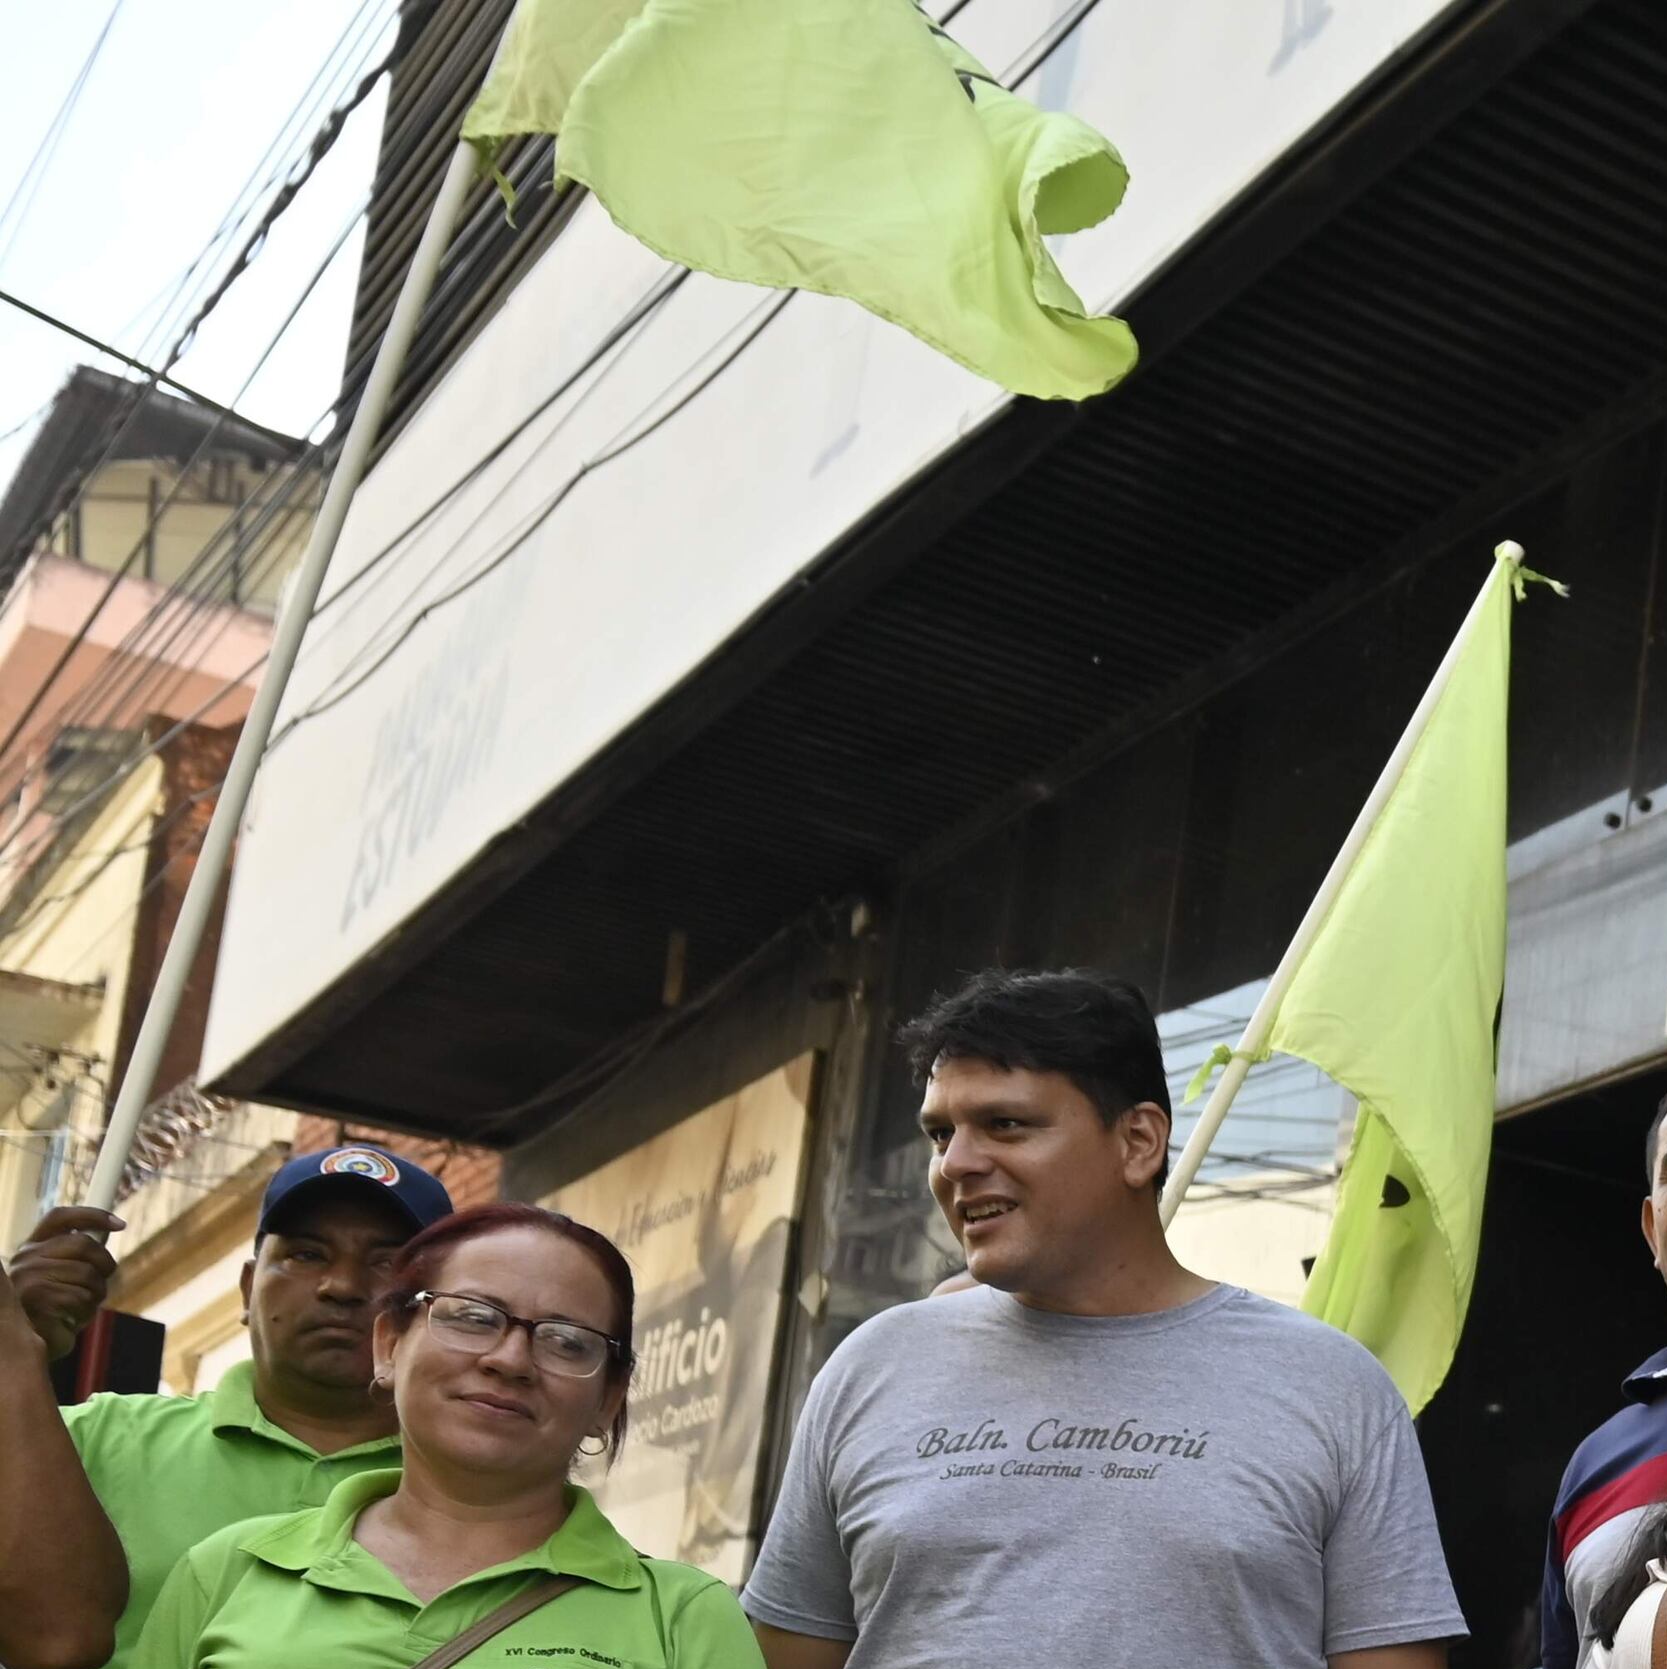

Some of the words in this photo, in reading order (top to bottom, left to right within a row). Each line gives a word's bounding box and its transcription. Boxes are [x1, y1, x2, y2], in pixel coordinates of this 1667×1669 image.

[916, 1419, 1008, 1459] Baln.
[1025, 1418, 1211, 1461] Camboriú
[940, 1460, 995, 1480] Santa
[1000, 1459, 1082, 1479] Catarina
[1101, 1462, 1163, 1480] Brasil
